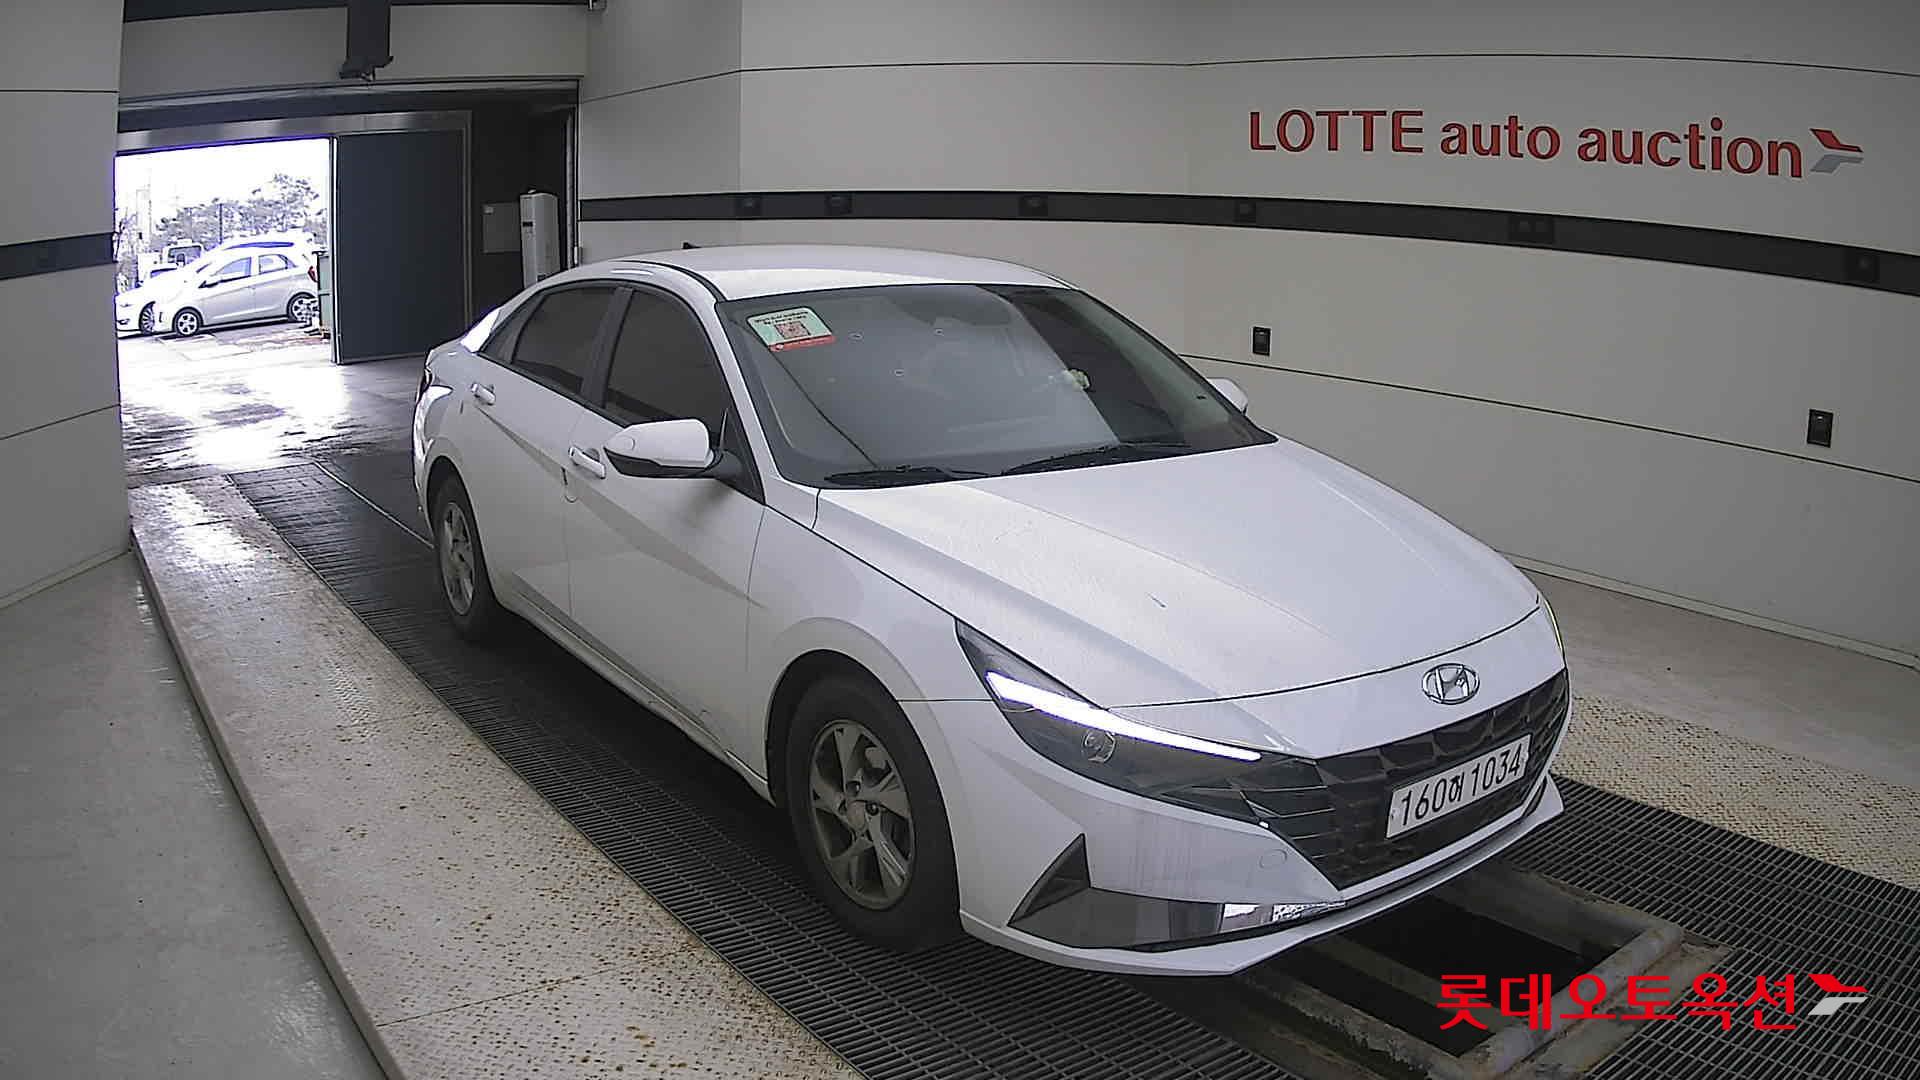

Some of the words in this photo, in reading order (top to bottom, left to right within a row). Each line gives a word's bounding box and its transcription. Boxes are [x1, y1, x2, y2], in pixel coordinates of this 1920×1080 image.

[1249, 110, 1424, 153] LOTTE
[1440, 115, 1561, 160] auto
[1577, 117, 1804, 178] auction
[1401, 770, 1465, 826] 160허
[1472, 743, 1522, 797] 1034
